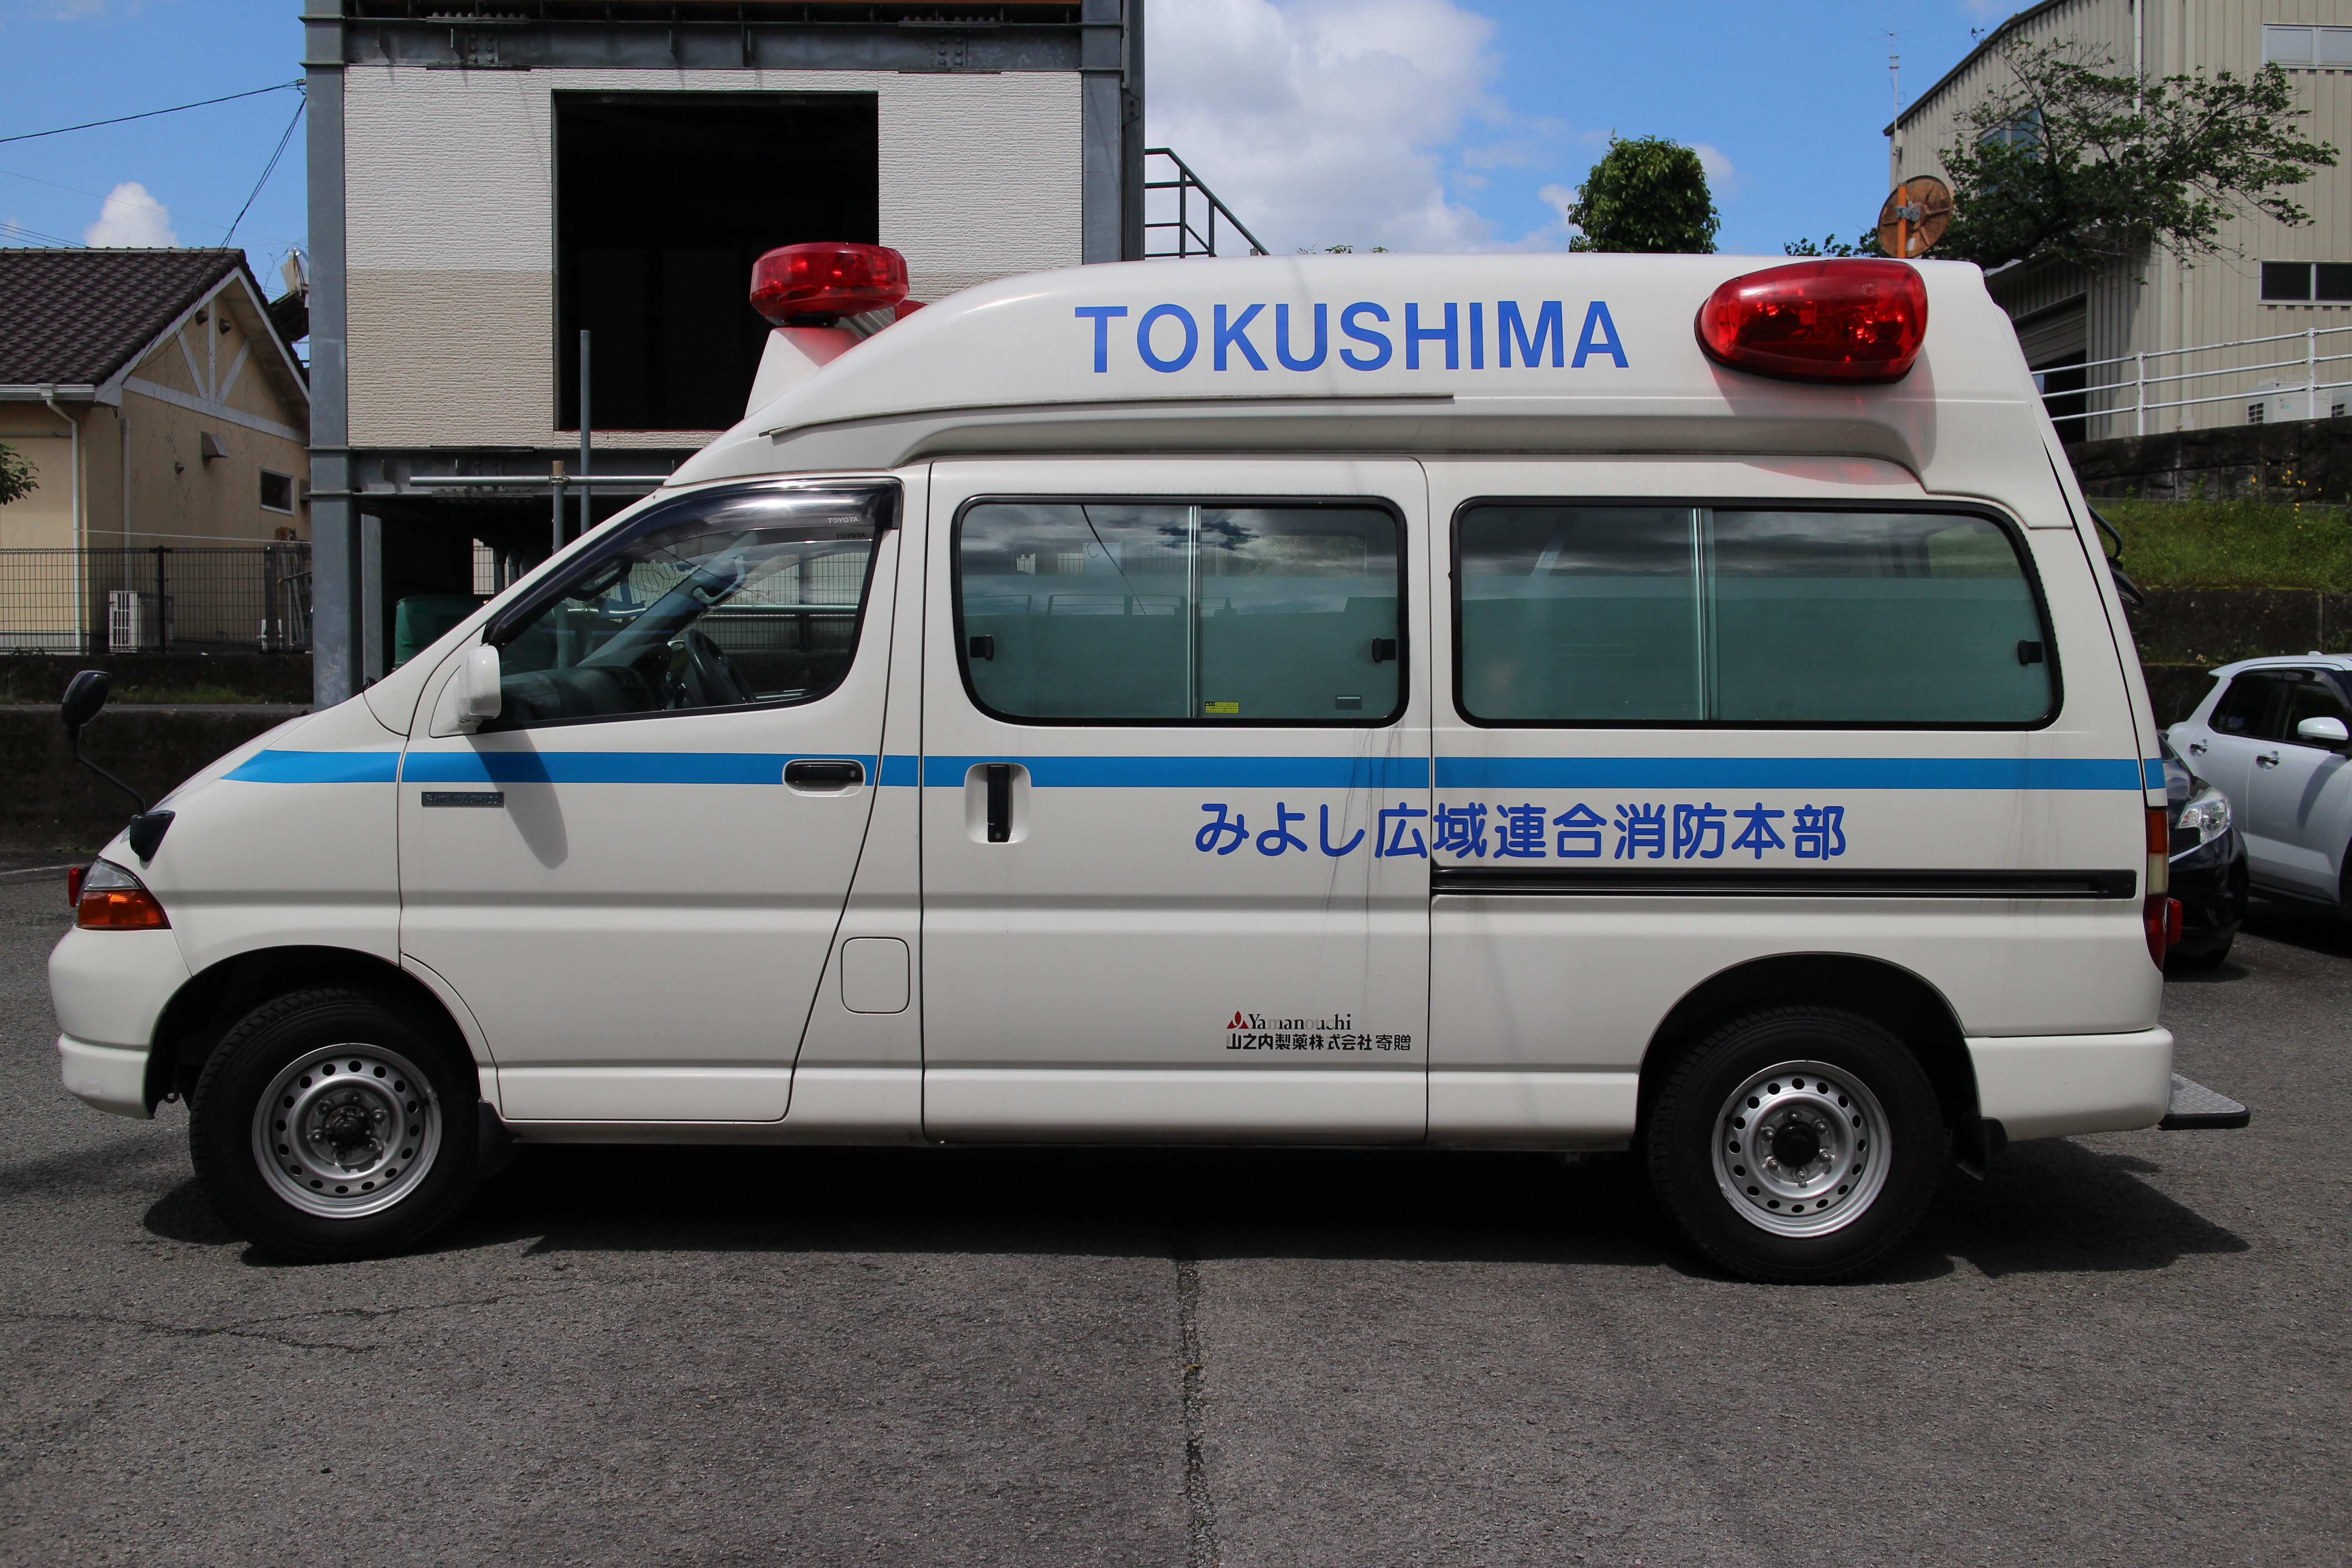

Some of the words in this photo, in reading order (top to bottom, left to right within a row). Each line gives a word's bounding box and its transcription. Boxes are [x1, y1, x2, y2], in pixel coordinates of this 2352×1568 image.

[1075, 301, 1629, 372] TOKUSHIMA
[423, 793, 503, 804] Ambulance
[1195, 803, 1846, 861] みよし広域連合消防本部
[1248, 1014, 1351, 1030] Yamanouchi
